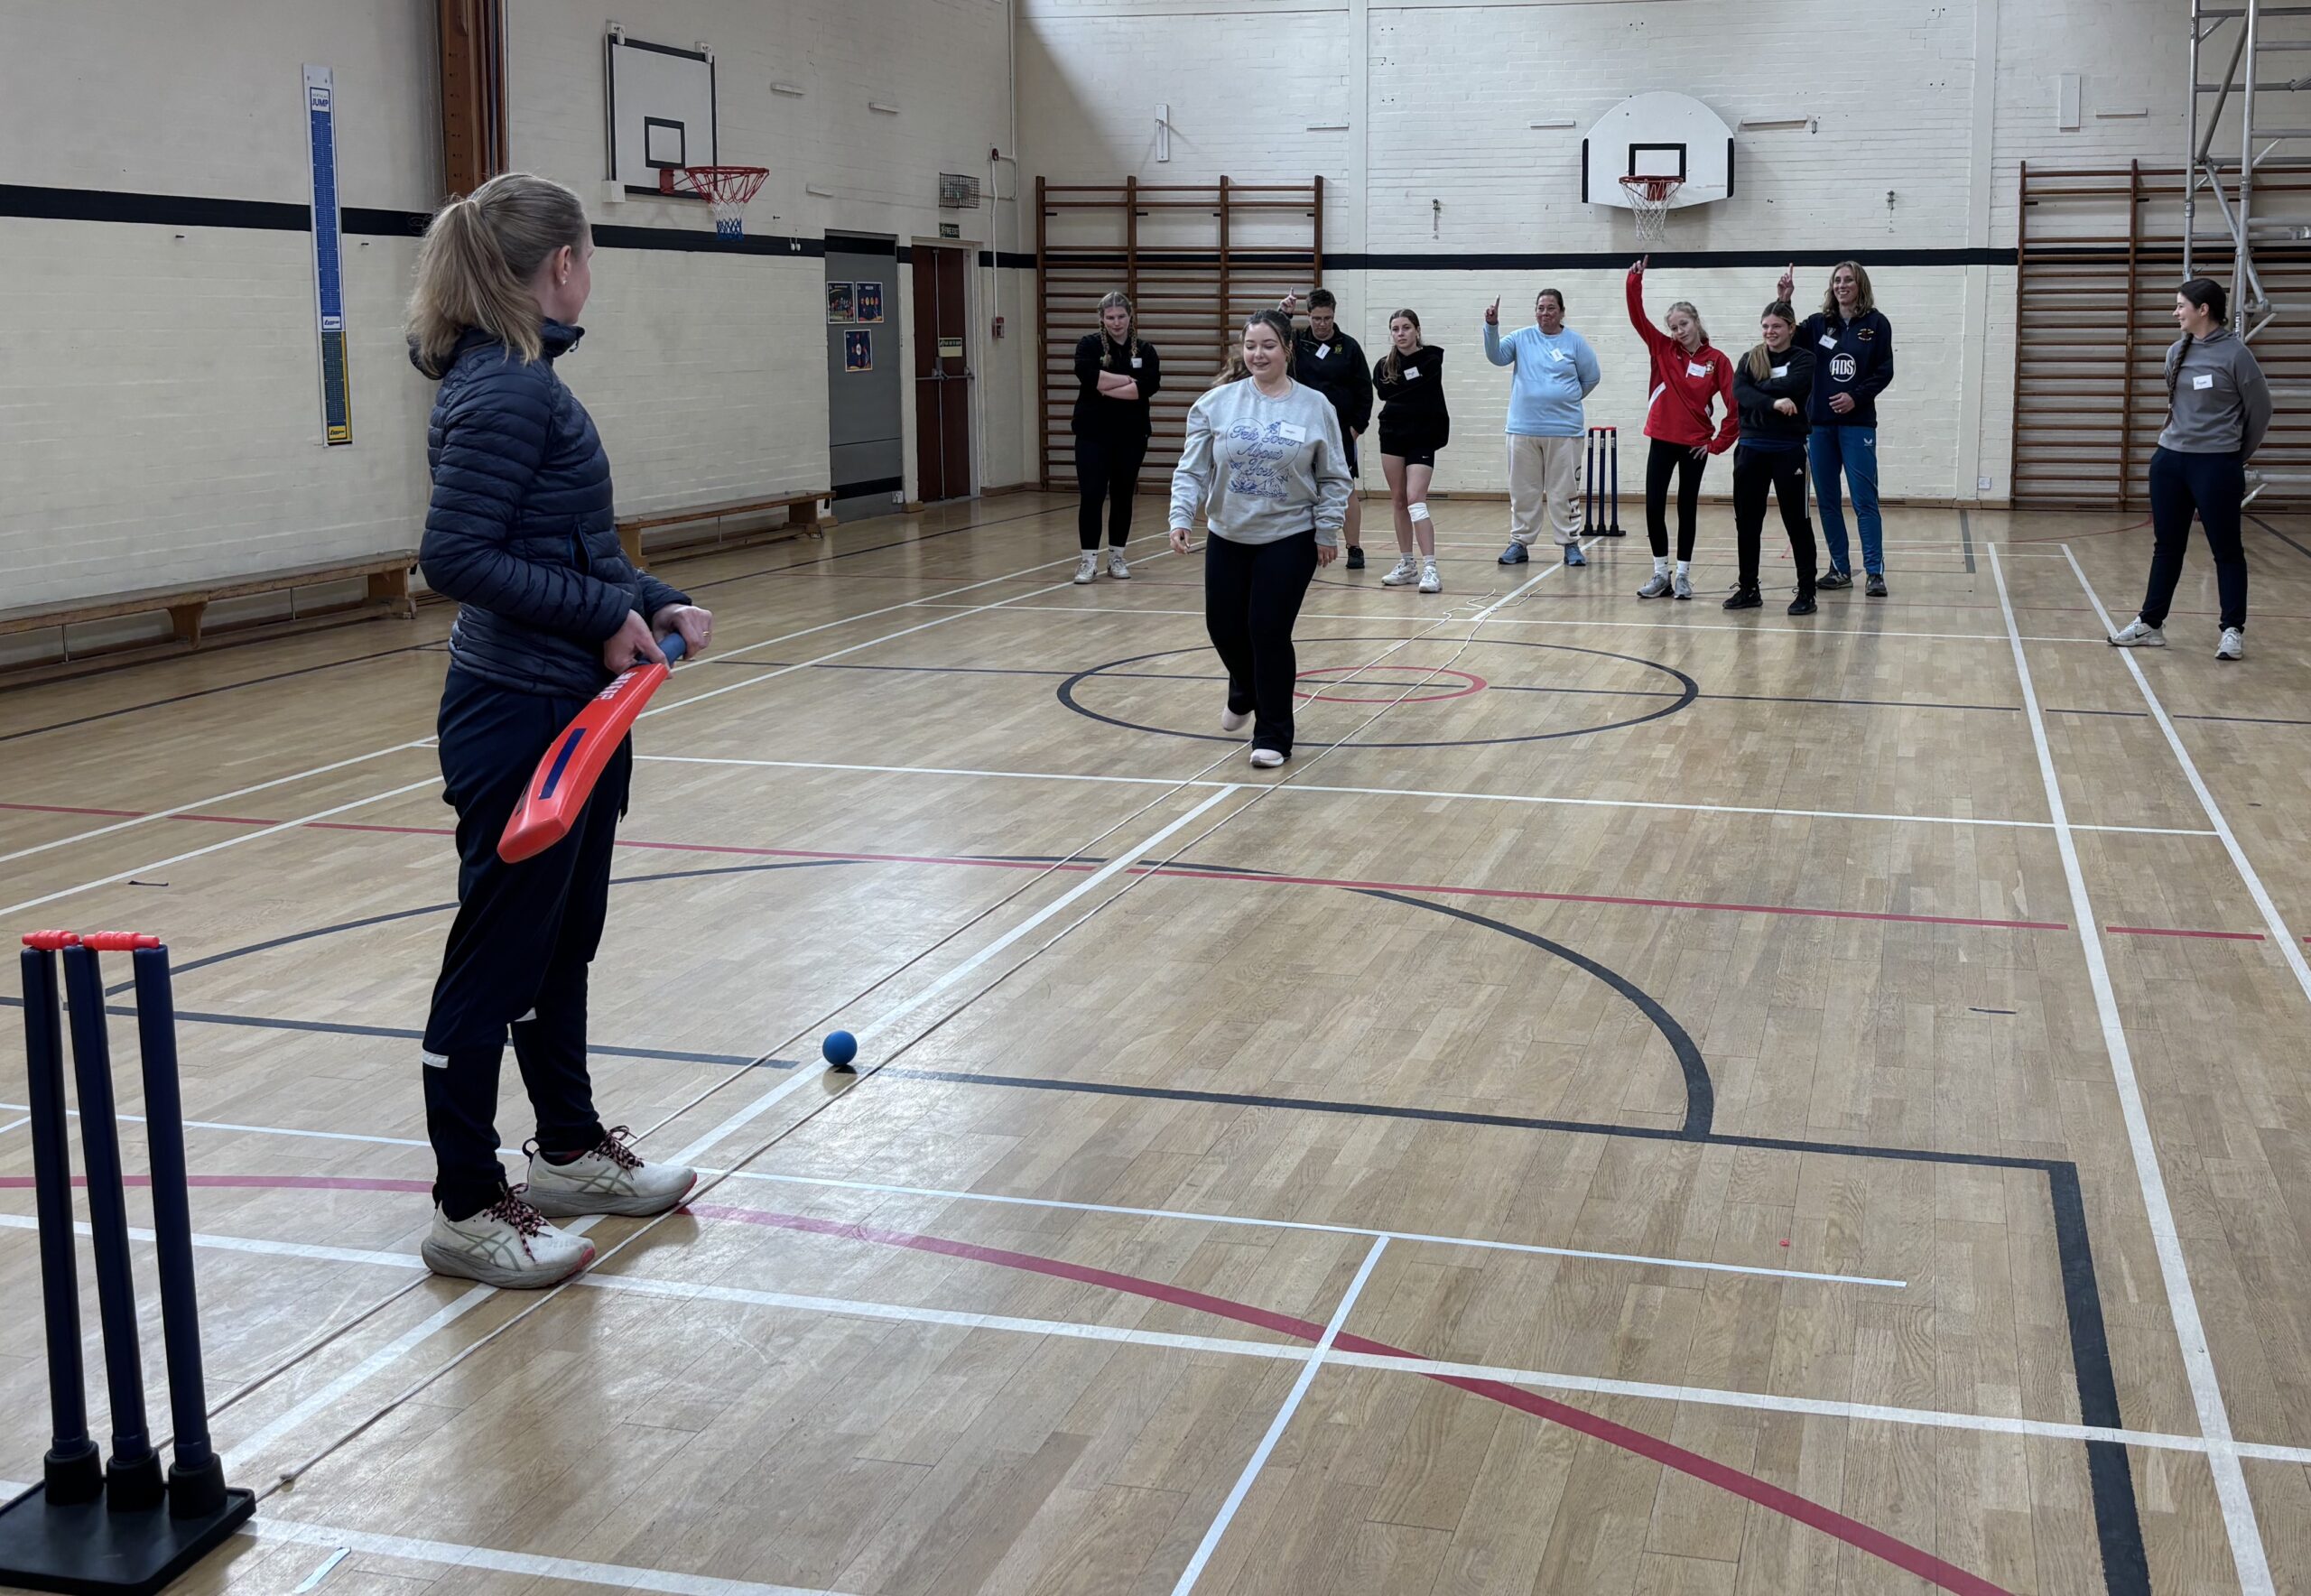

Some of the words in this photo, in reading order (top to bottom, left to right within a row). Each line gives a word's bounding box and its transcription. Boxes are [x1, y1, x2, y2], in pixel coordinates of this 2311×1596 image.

[312, 97, 329, 107] JUMP
[1831, 359, 1854, 376] ADS
[1237, 441, 1284, 460] About
[1244, 458, 1276, 477] You
